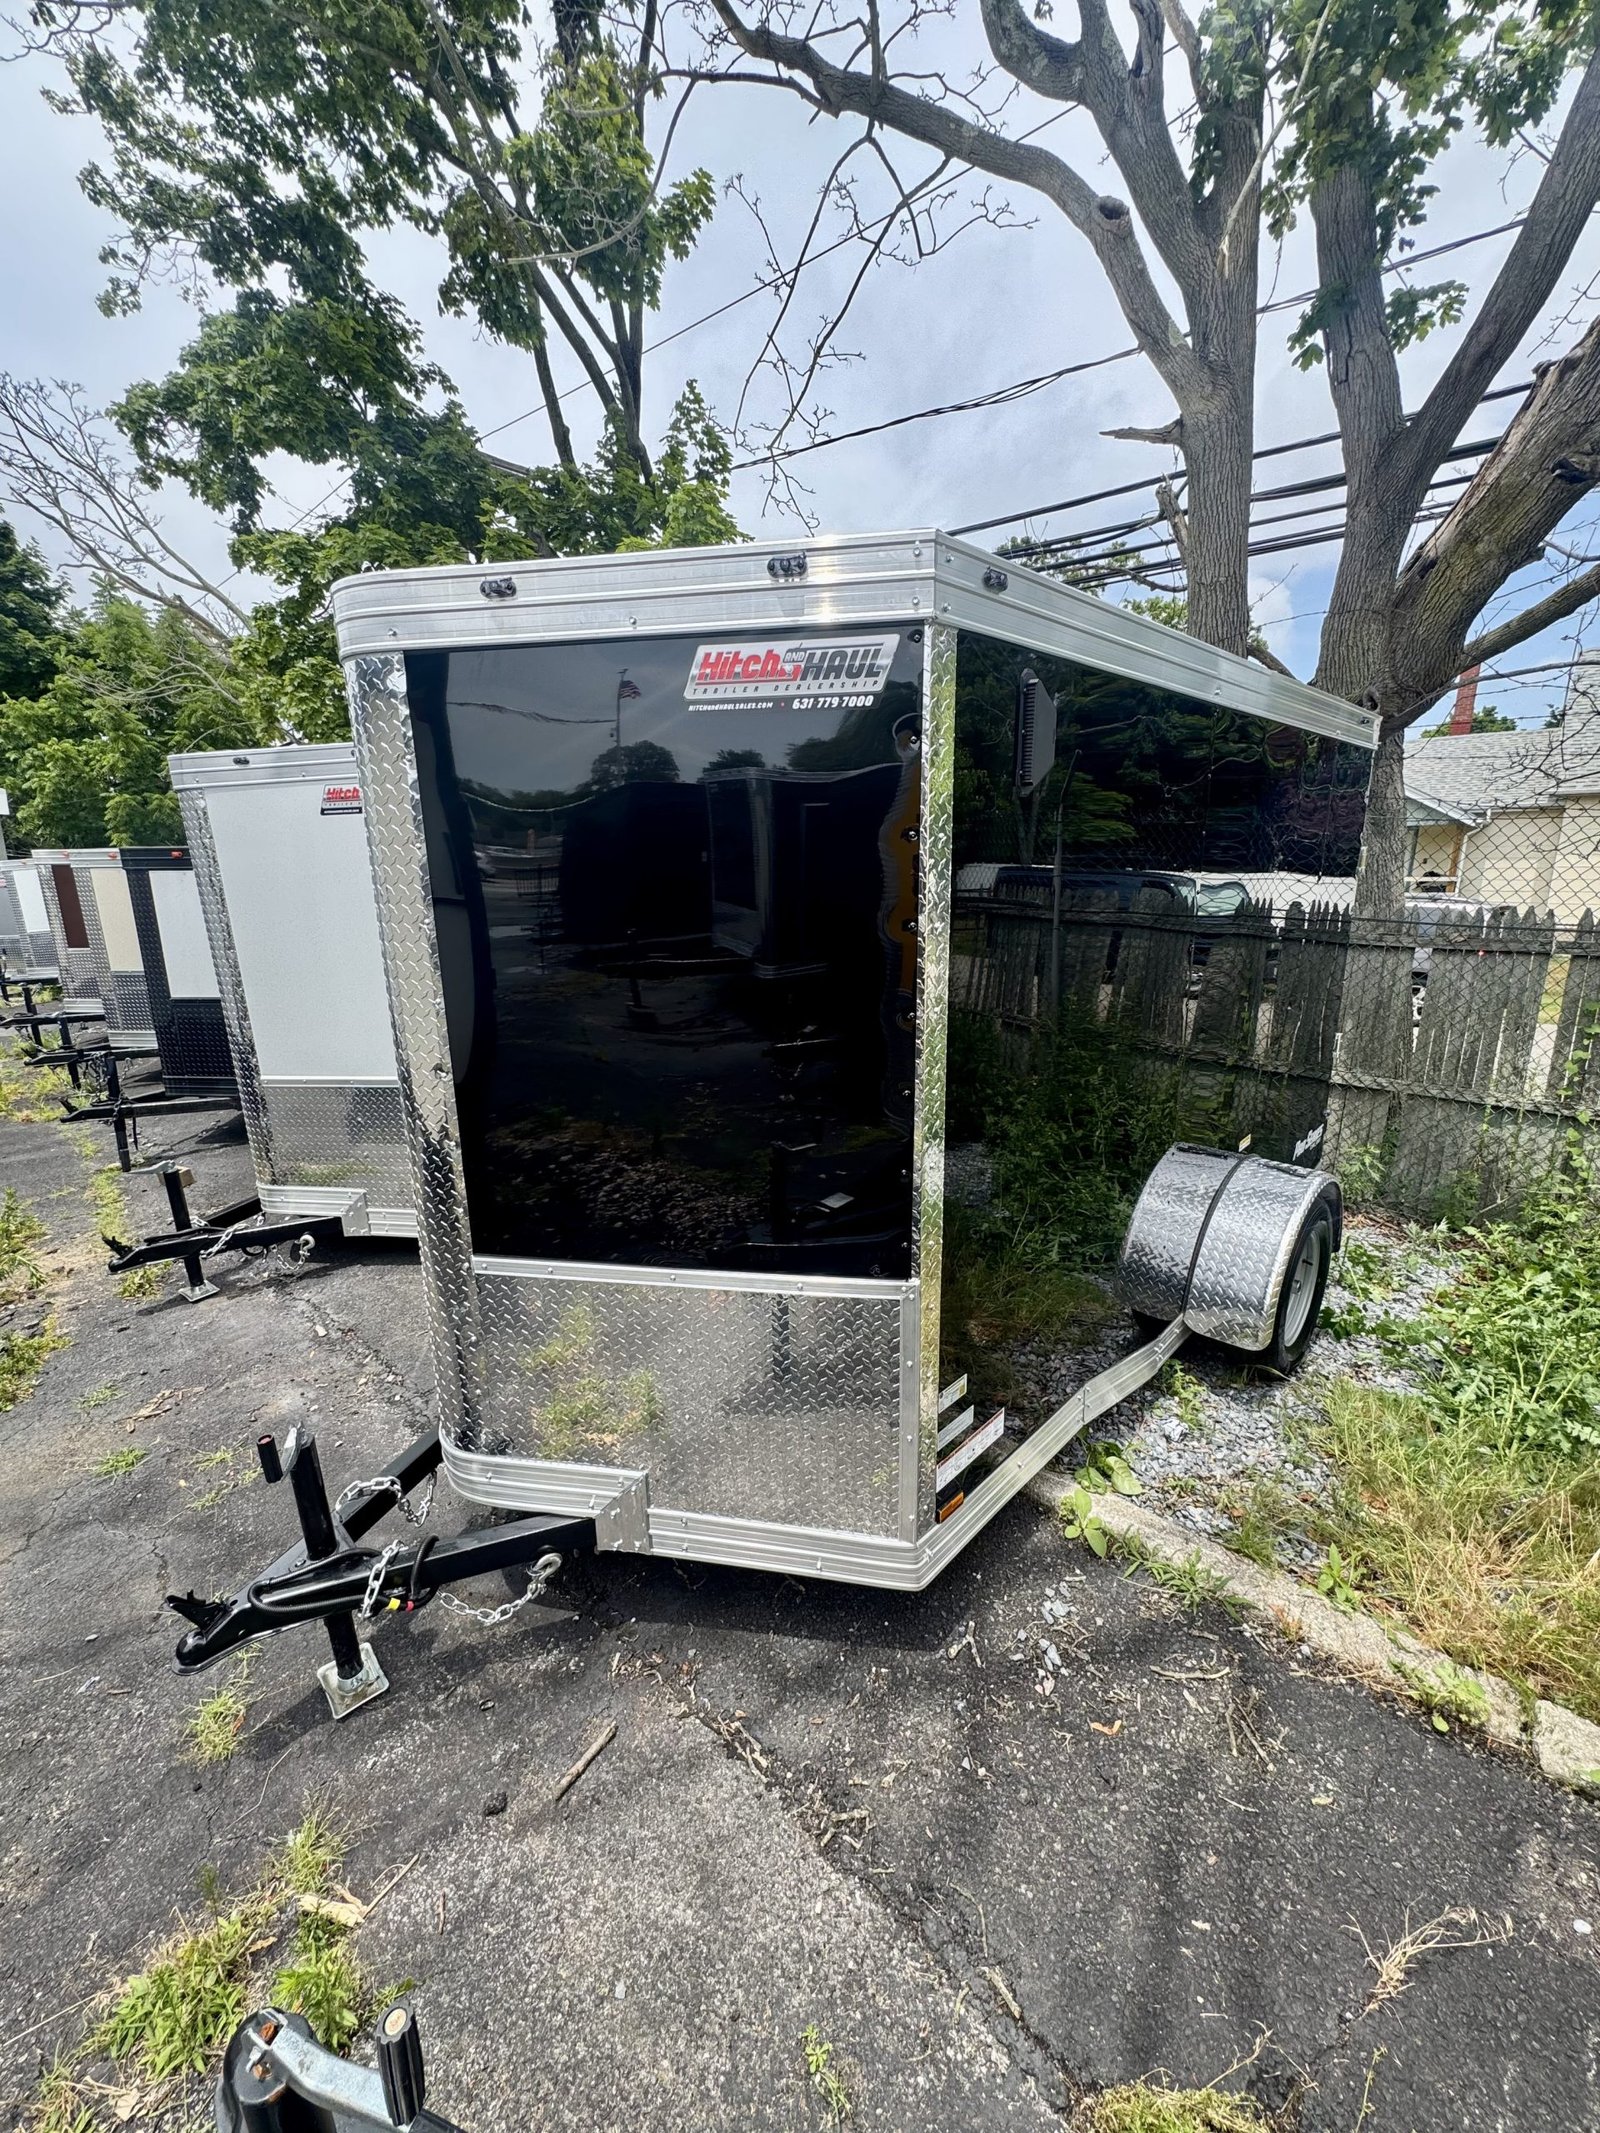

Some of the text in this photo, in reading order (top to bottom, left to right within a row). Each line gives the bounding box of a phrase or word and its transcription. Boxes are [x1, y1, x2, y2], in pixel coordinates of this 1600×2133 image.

[697, 647, 884, 681] Hitch AND HAUL
[693, 680, 879, 695] TRAILER DEALERSHIP
[326, 787, 361, 800] Hitch
